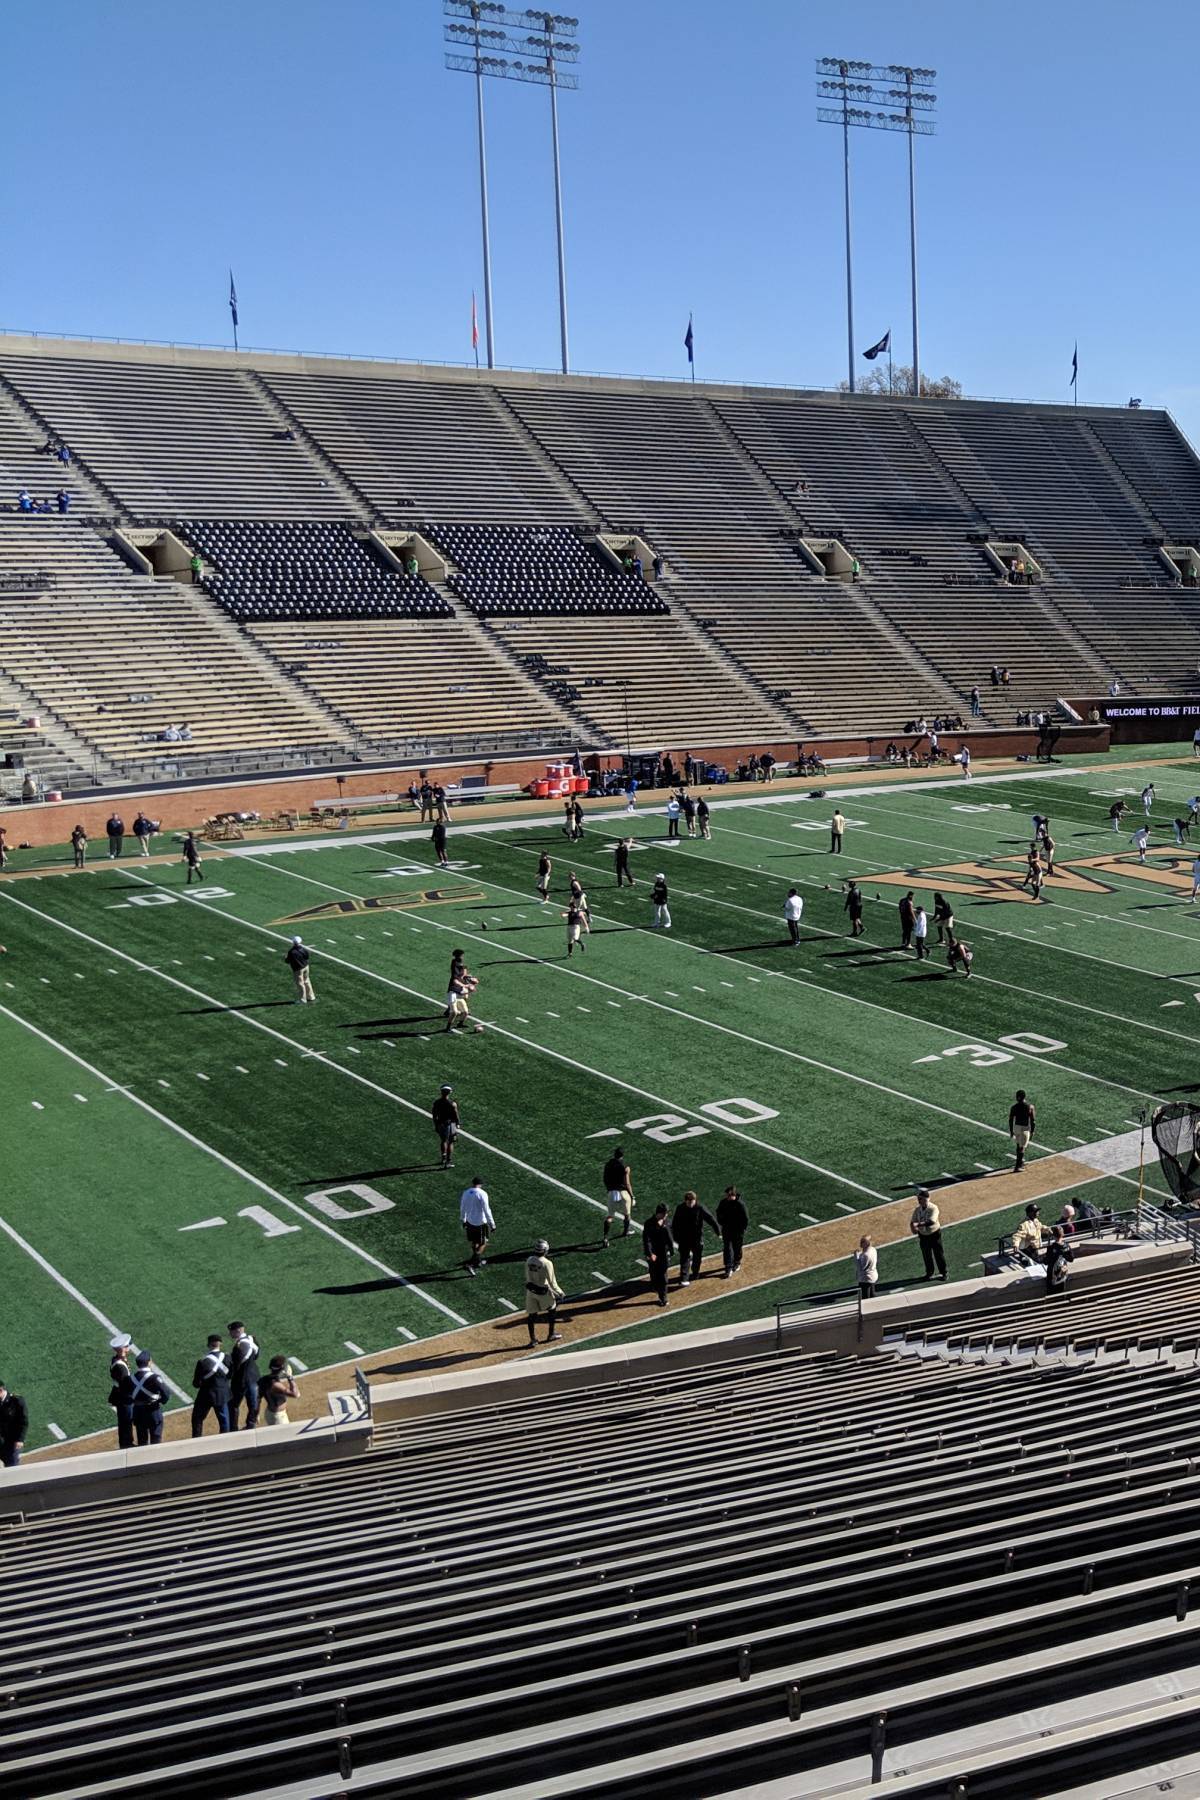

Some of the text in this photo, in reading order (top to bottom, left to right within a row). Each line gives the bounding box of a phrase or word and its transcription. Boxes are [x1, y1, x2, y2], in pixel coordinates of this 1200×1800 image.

[1106, 707, 1147, 718] WELCOME
[1148, 707, 1160, 717] TO
[1161, 706, 1180, 716] BB&T
[941, 1032, 1068, 1066] 30
[624, 1097, 781, 1144] 20
[237, 1184, 397, 1238] 10
